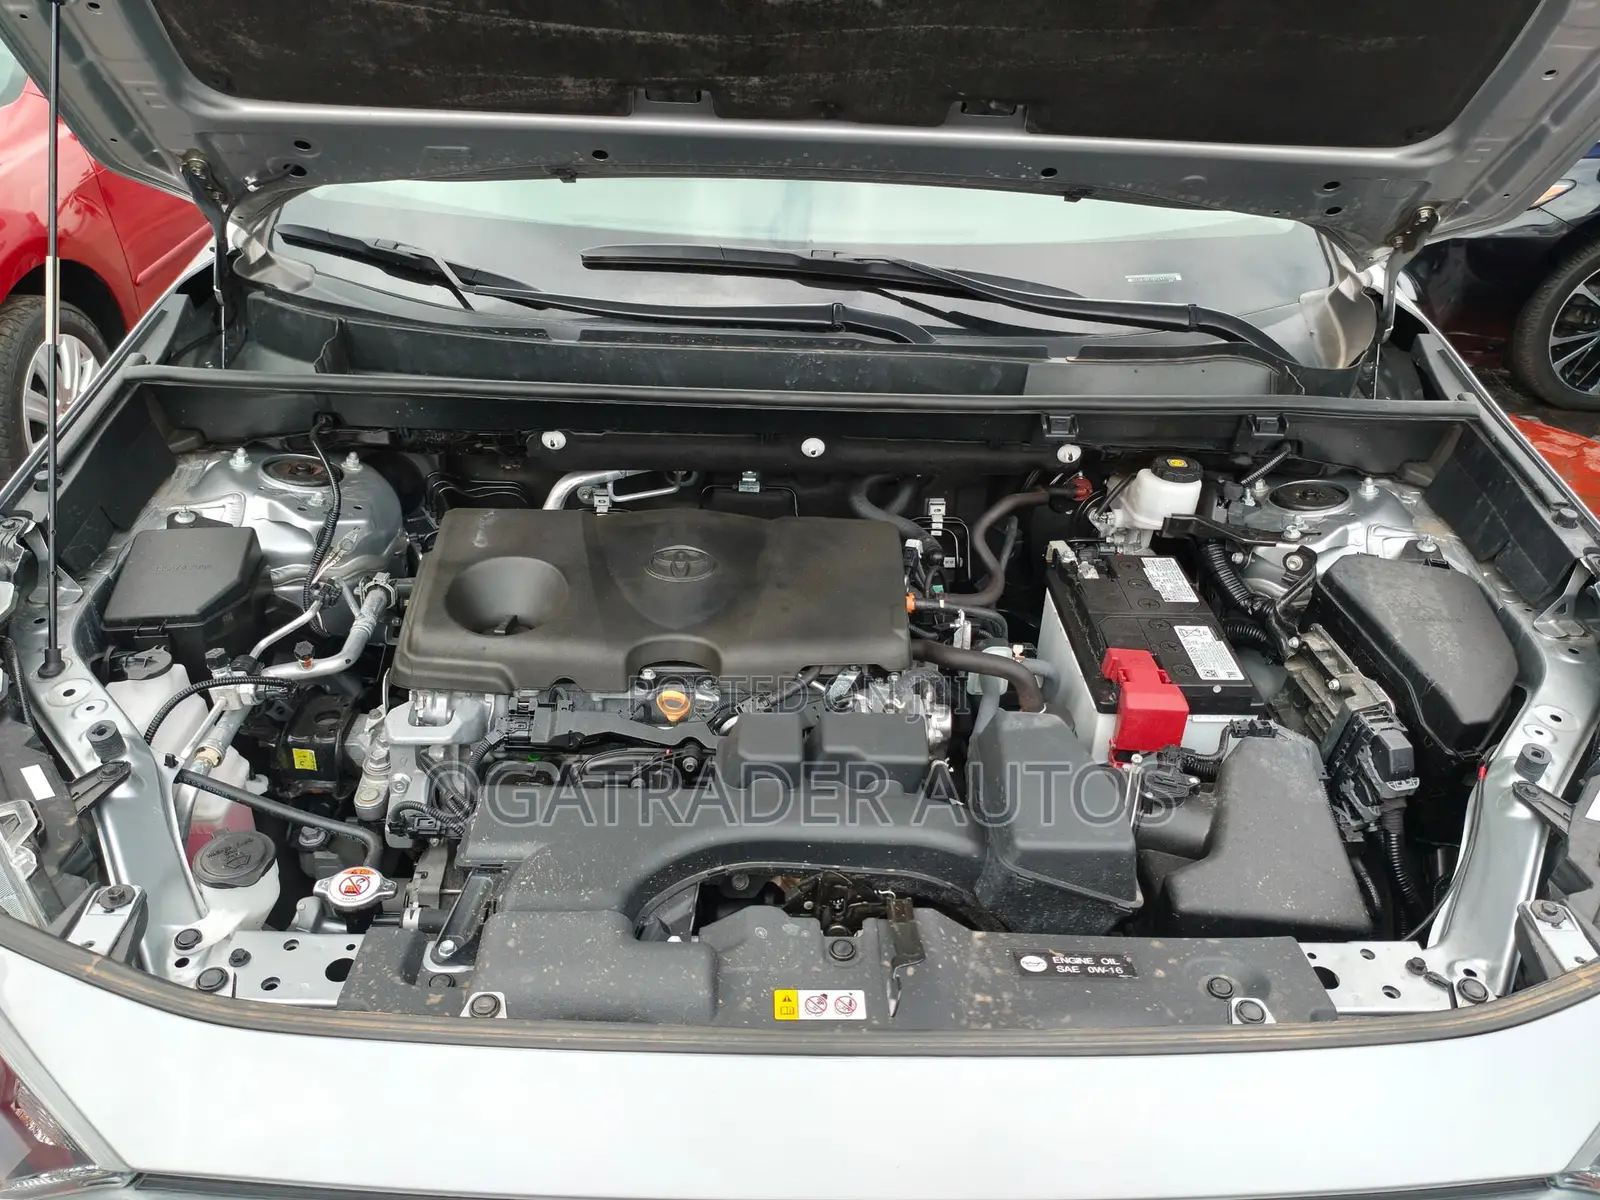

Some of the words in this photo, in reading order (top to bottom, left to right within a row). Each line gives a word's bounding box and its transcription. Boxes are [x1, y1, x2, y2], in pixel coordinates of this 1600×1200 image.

[1052, 956, 1095, 965] ENGINE
[1100, 957, 1121, 966] OIL
[1056, 965, 1081, 973] SAE
[1087, 966, 1124, 974] 0W-16
